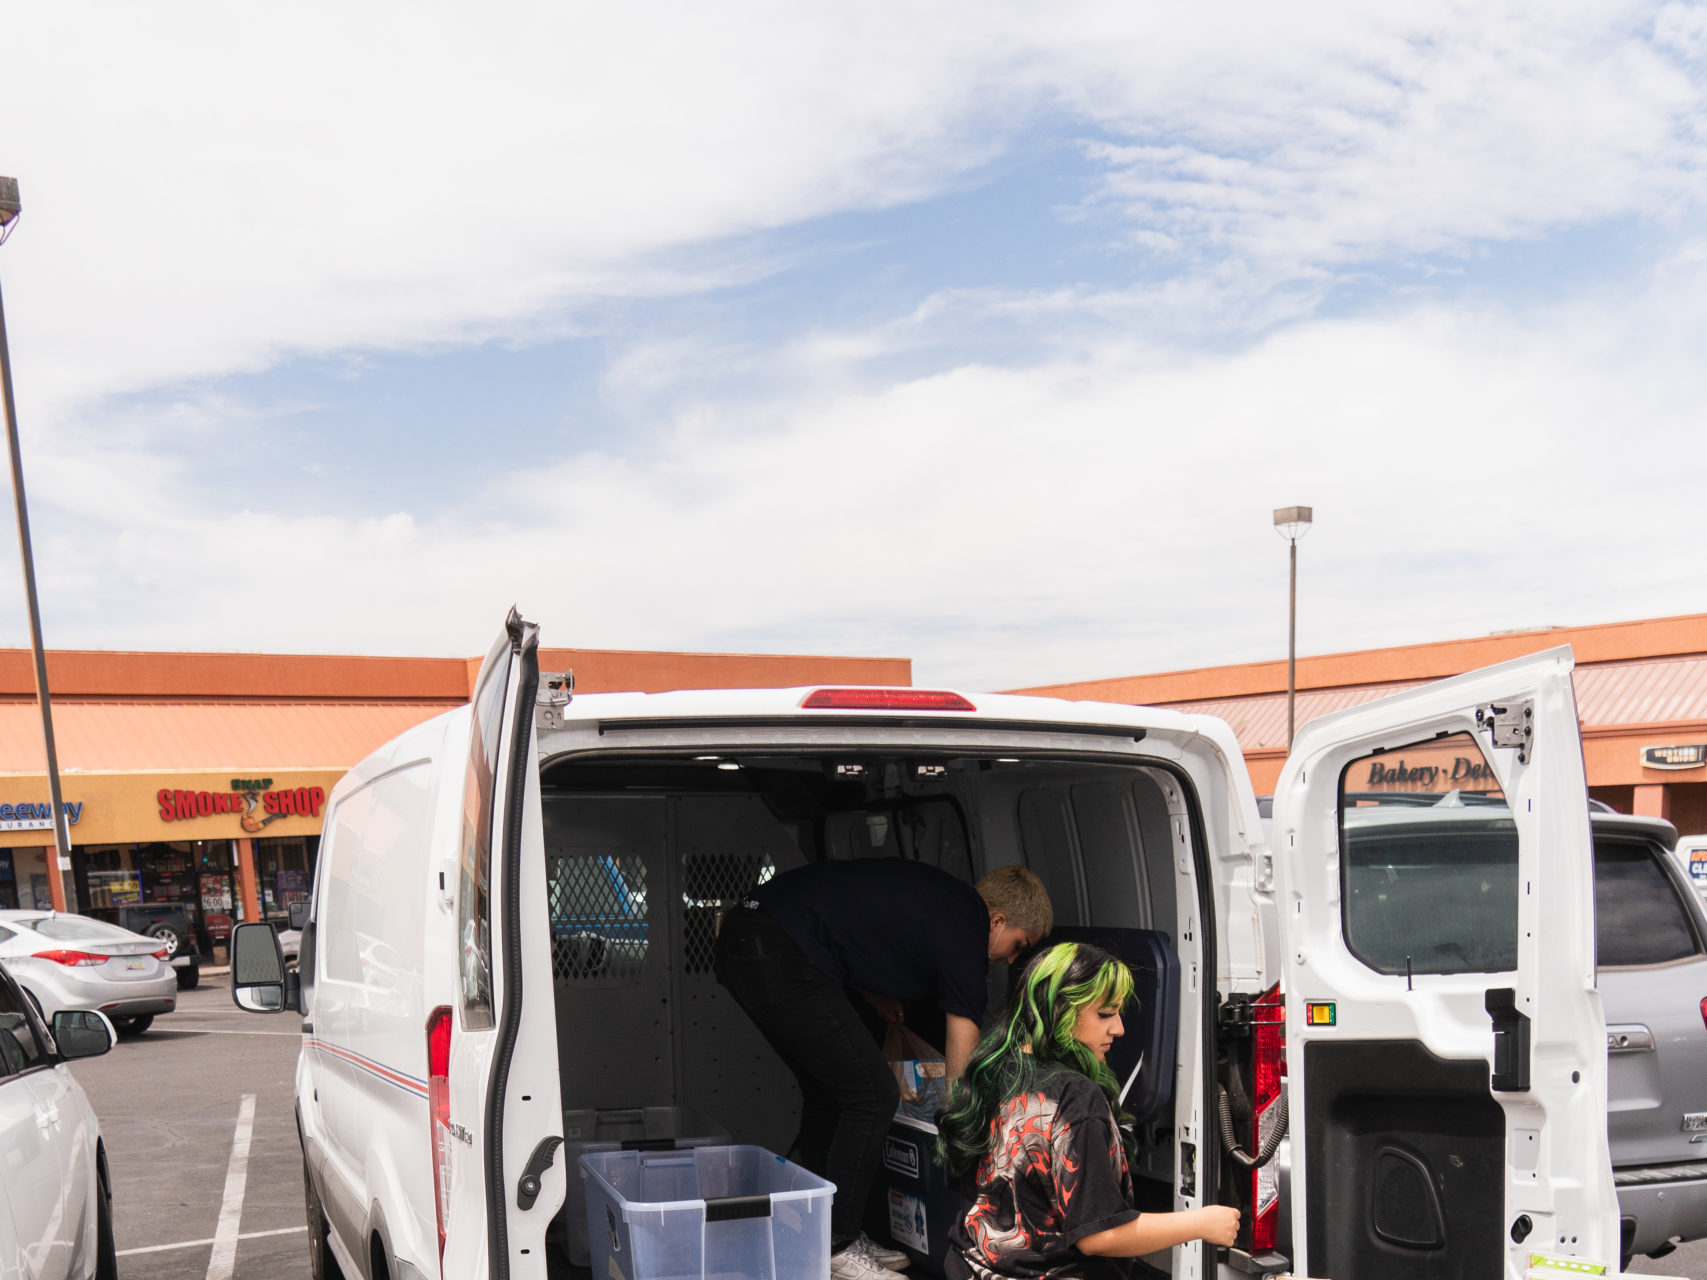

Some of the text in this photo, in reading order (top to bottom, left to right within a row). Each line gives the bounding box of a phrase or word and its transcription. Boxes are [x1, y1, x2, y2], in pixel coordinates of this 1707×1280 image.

[1367, 760, 1439, 787] Bakery
[157, 787, 325, 822] SMOKE SHOP
